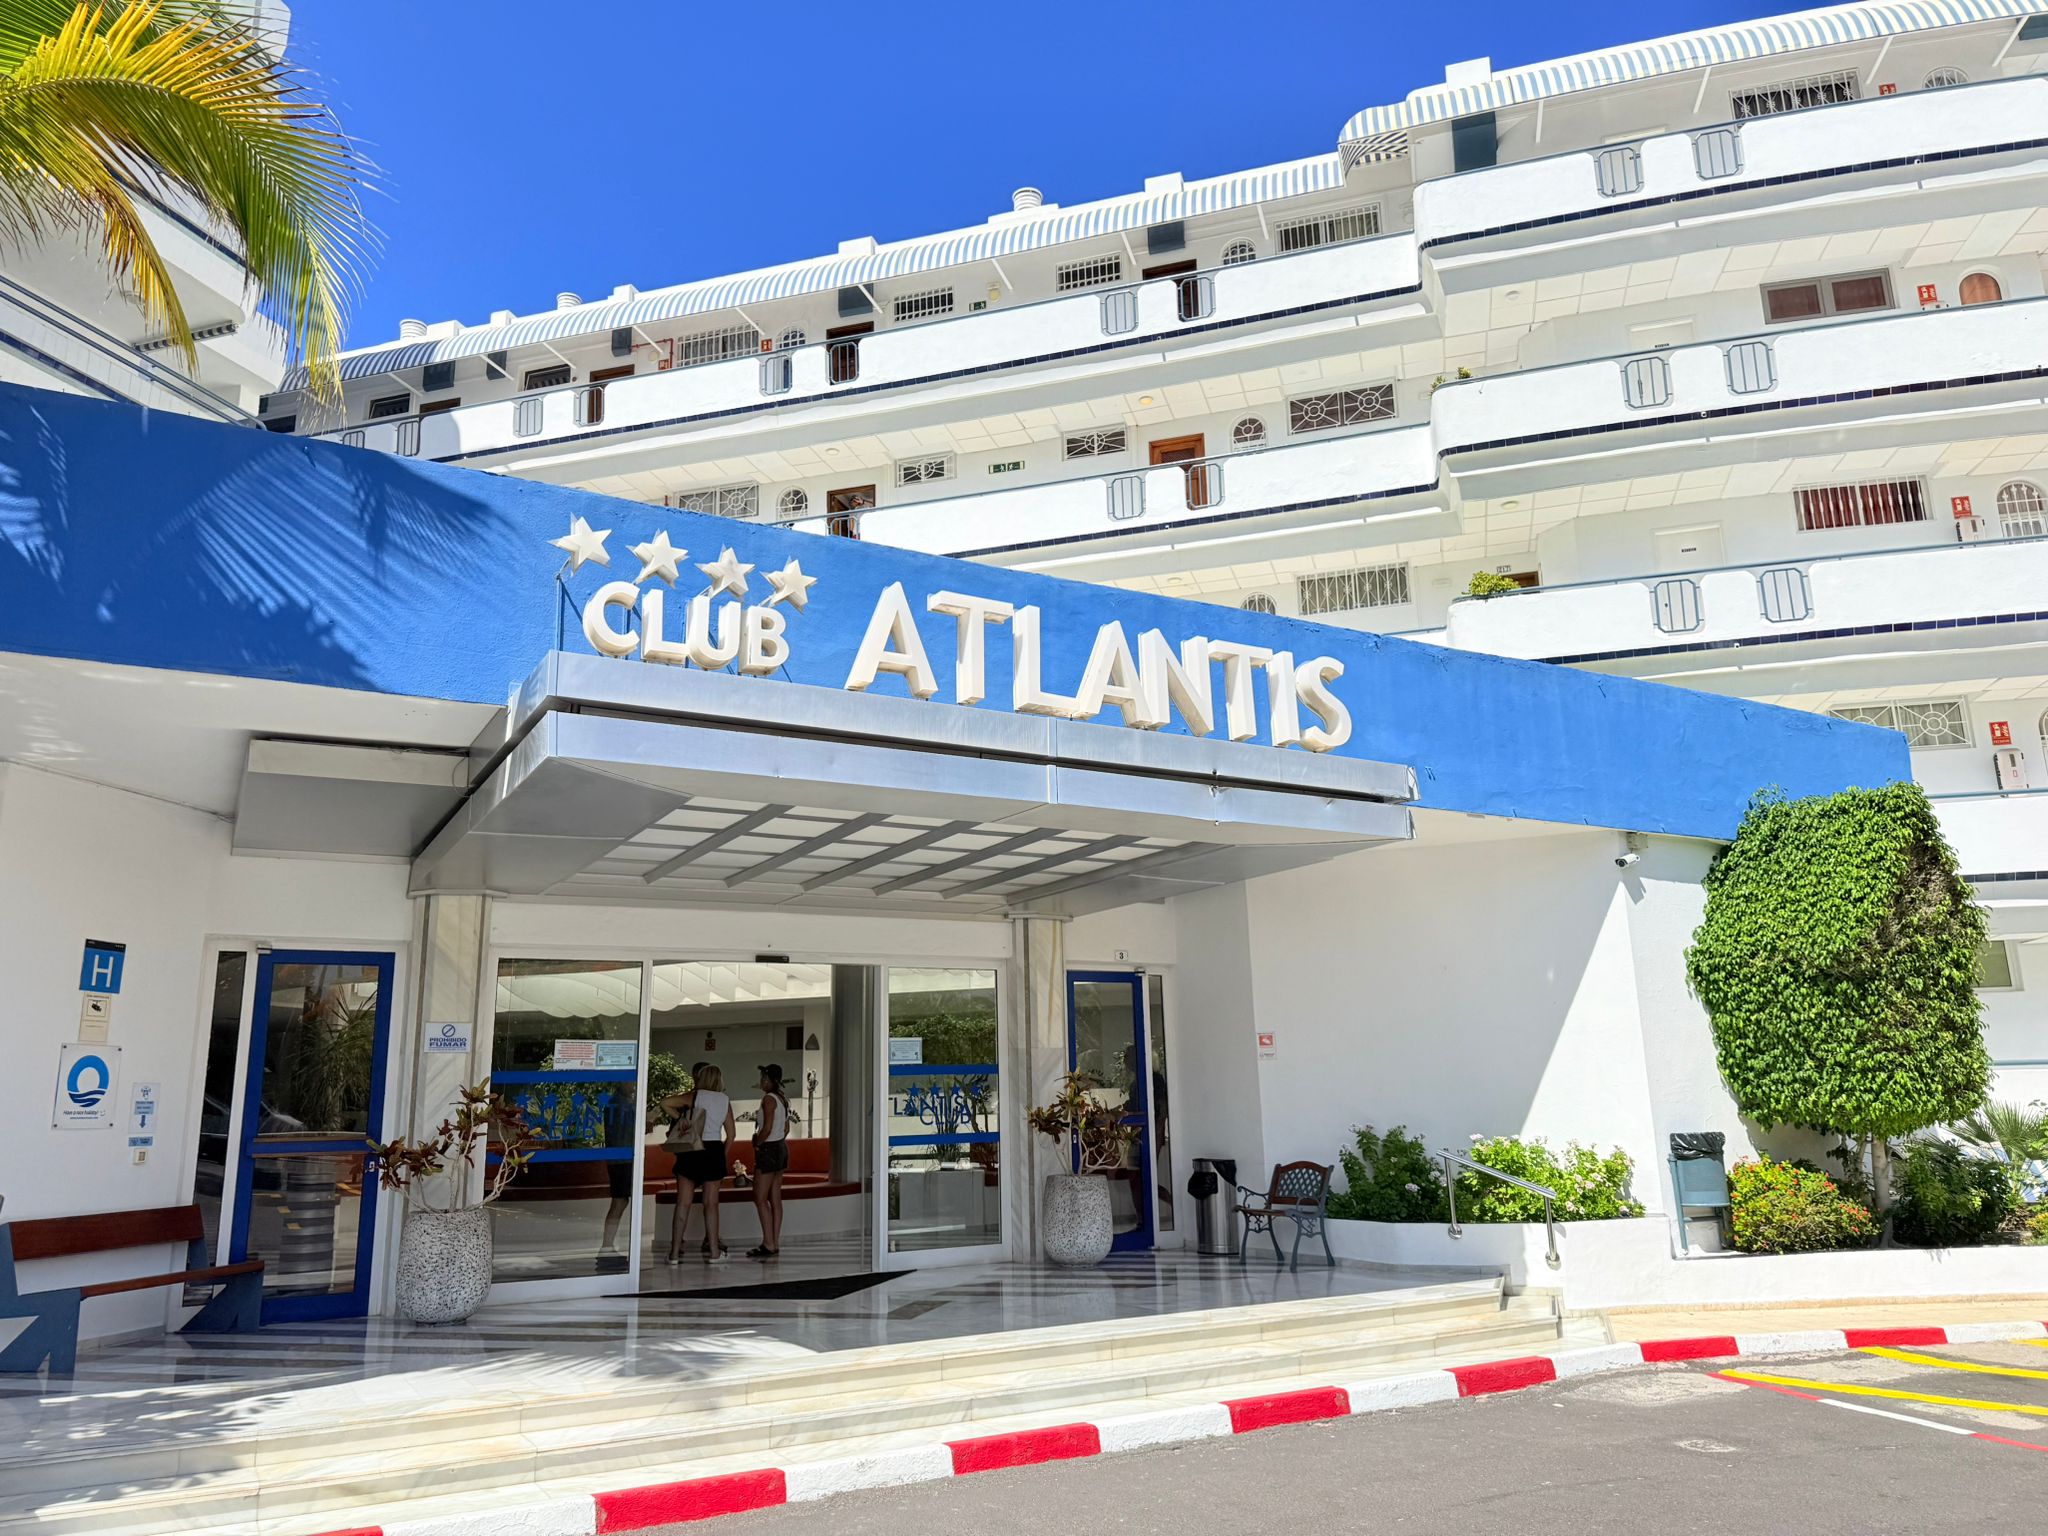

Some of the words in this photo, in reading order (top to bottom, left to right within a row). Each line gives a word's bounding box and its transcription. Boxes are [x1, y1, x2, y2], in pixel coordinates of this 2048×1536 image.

[583, 580, 789, 676] CLUB
[844, 580, 1352, 752] ATLANTIS
[91, 954, 114, 988] H
